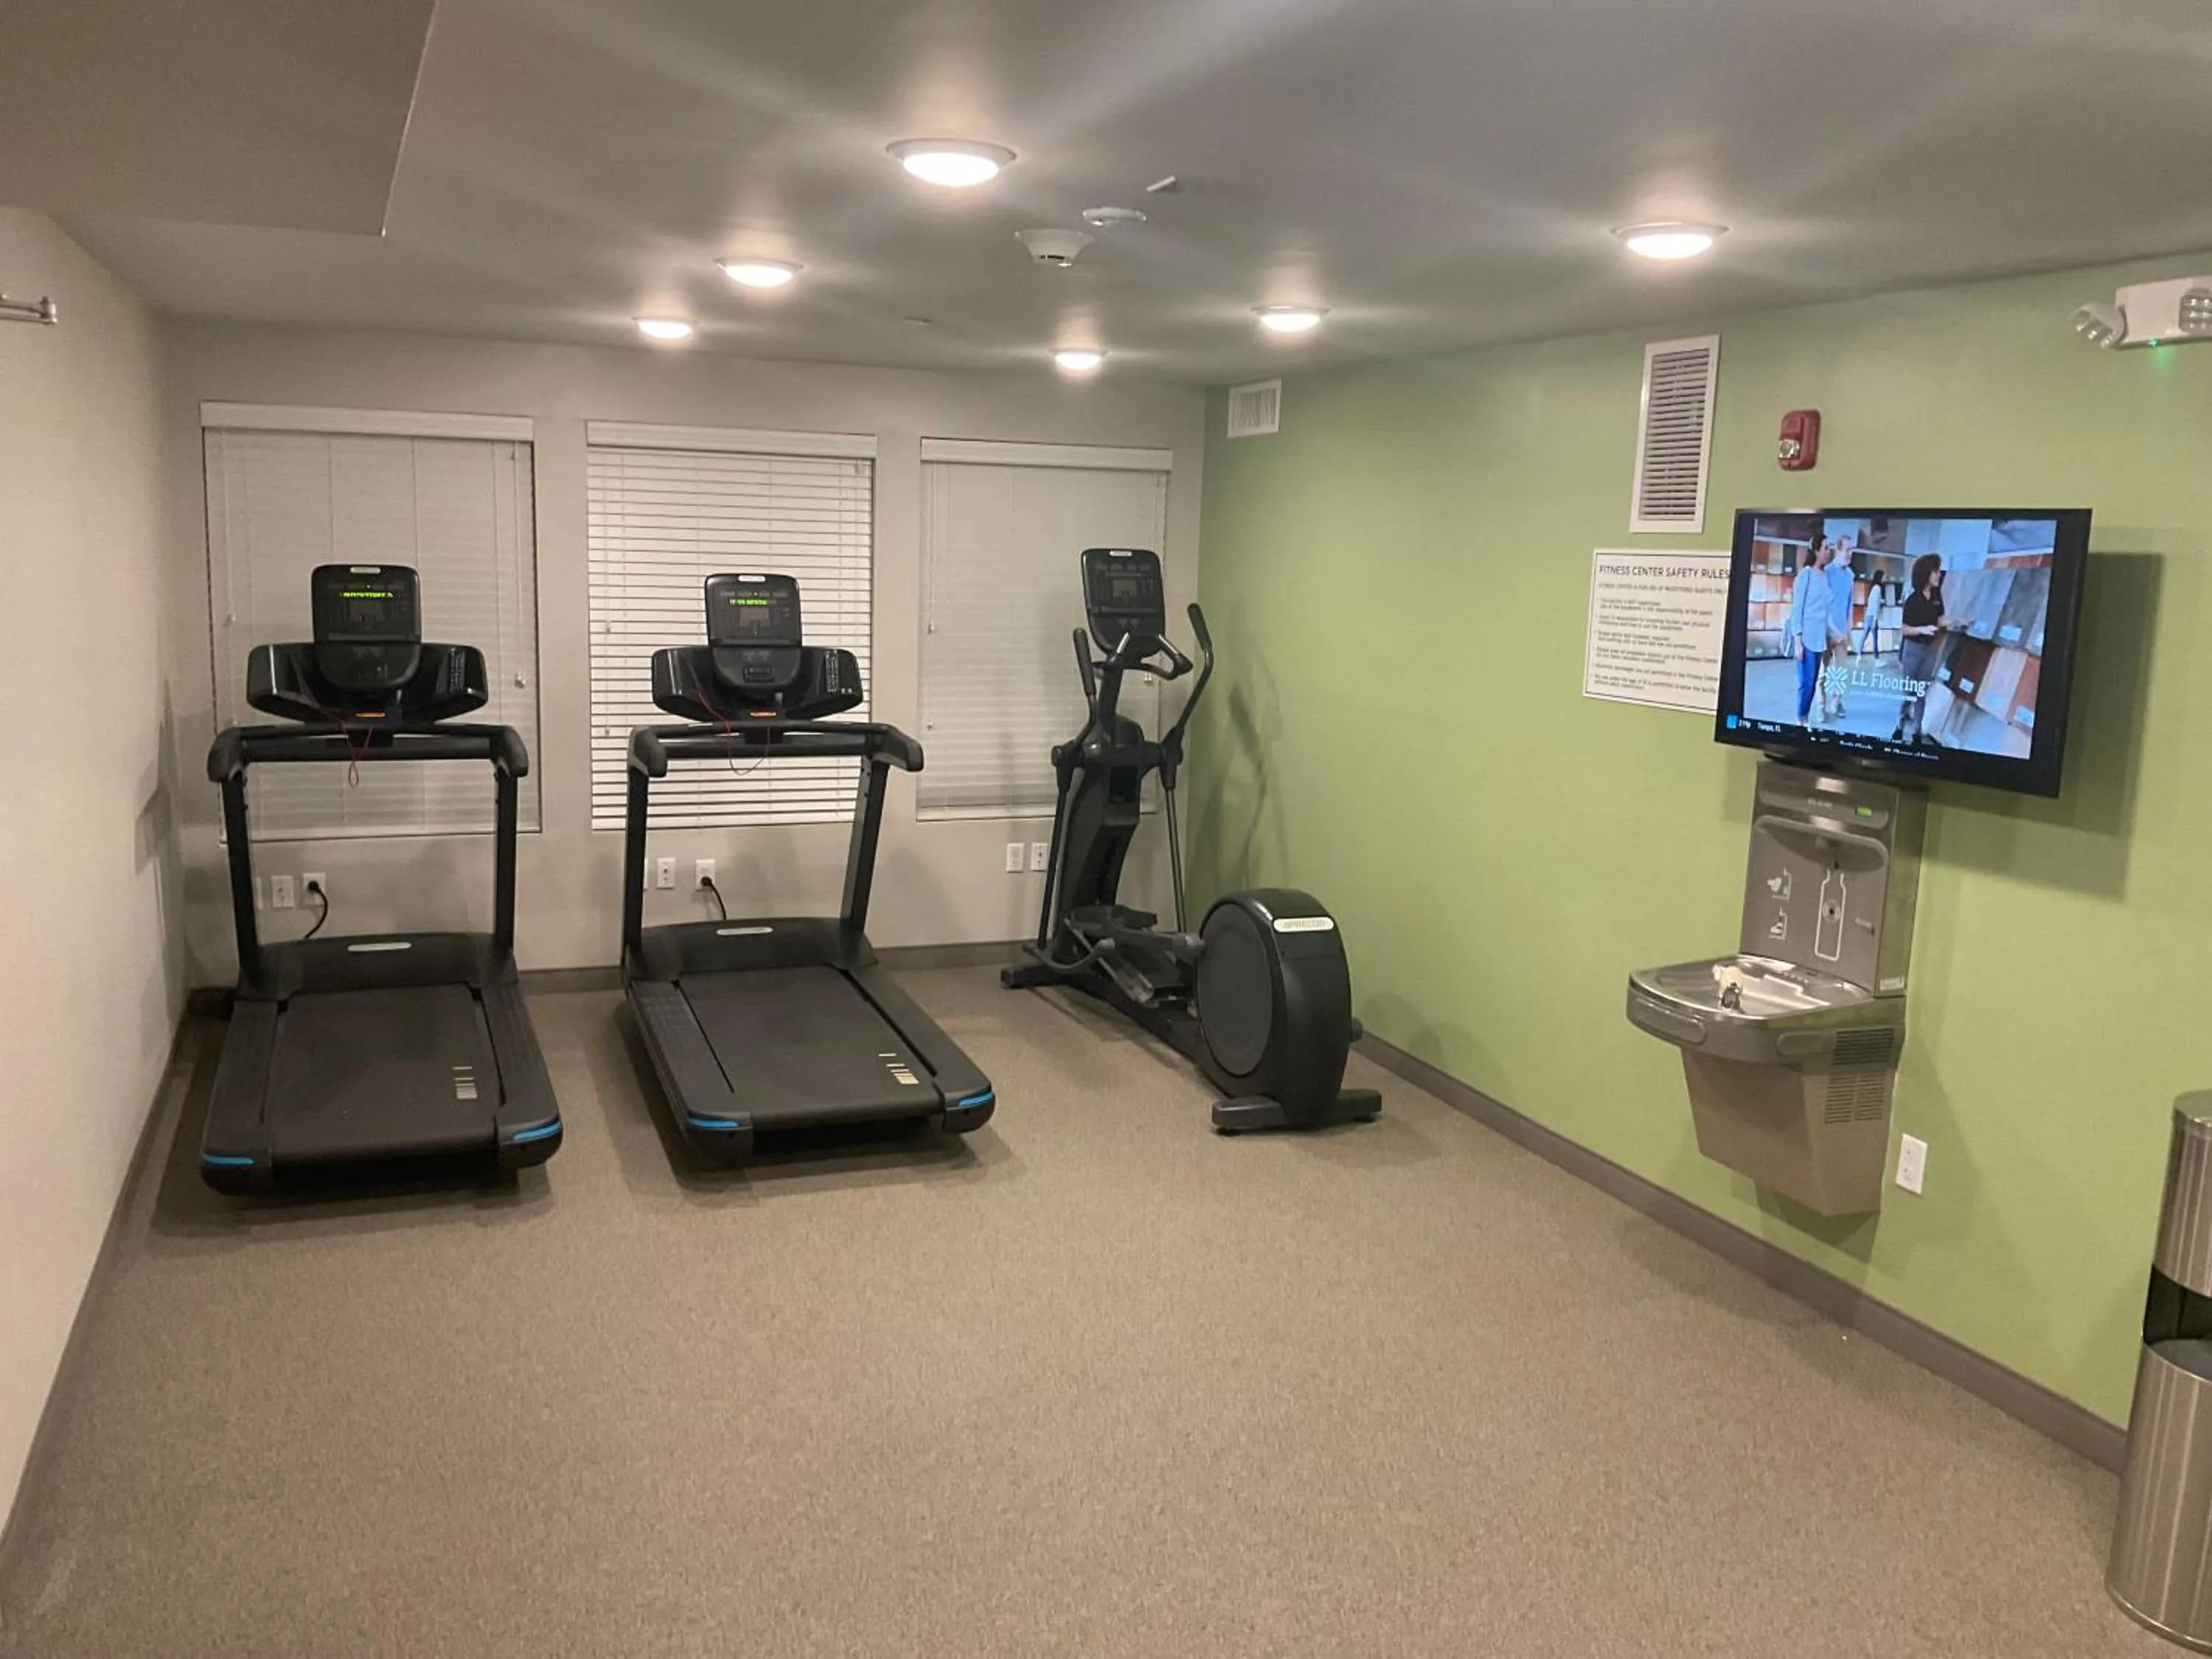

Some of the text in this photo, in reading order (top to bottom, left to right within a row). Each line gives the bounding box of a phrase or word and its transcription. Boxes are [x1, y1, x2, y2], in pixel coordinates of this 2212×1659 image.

[1599, 566, 1731, 579] FITNESS CENTER SAFETY RULES
[1851, 670, 1868, 686] LL
[1869, 673, 1925, 697] Flooring
